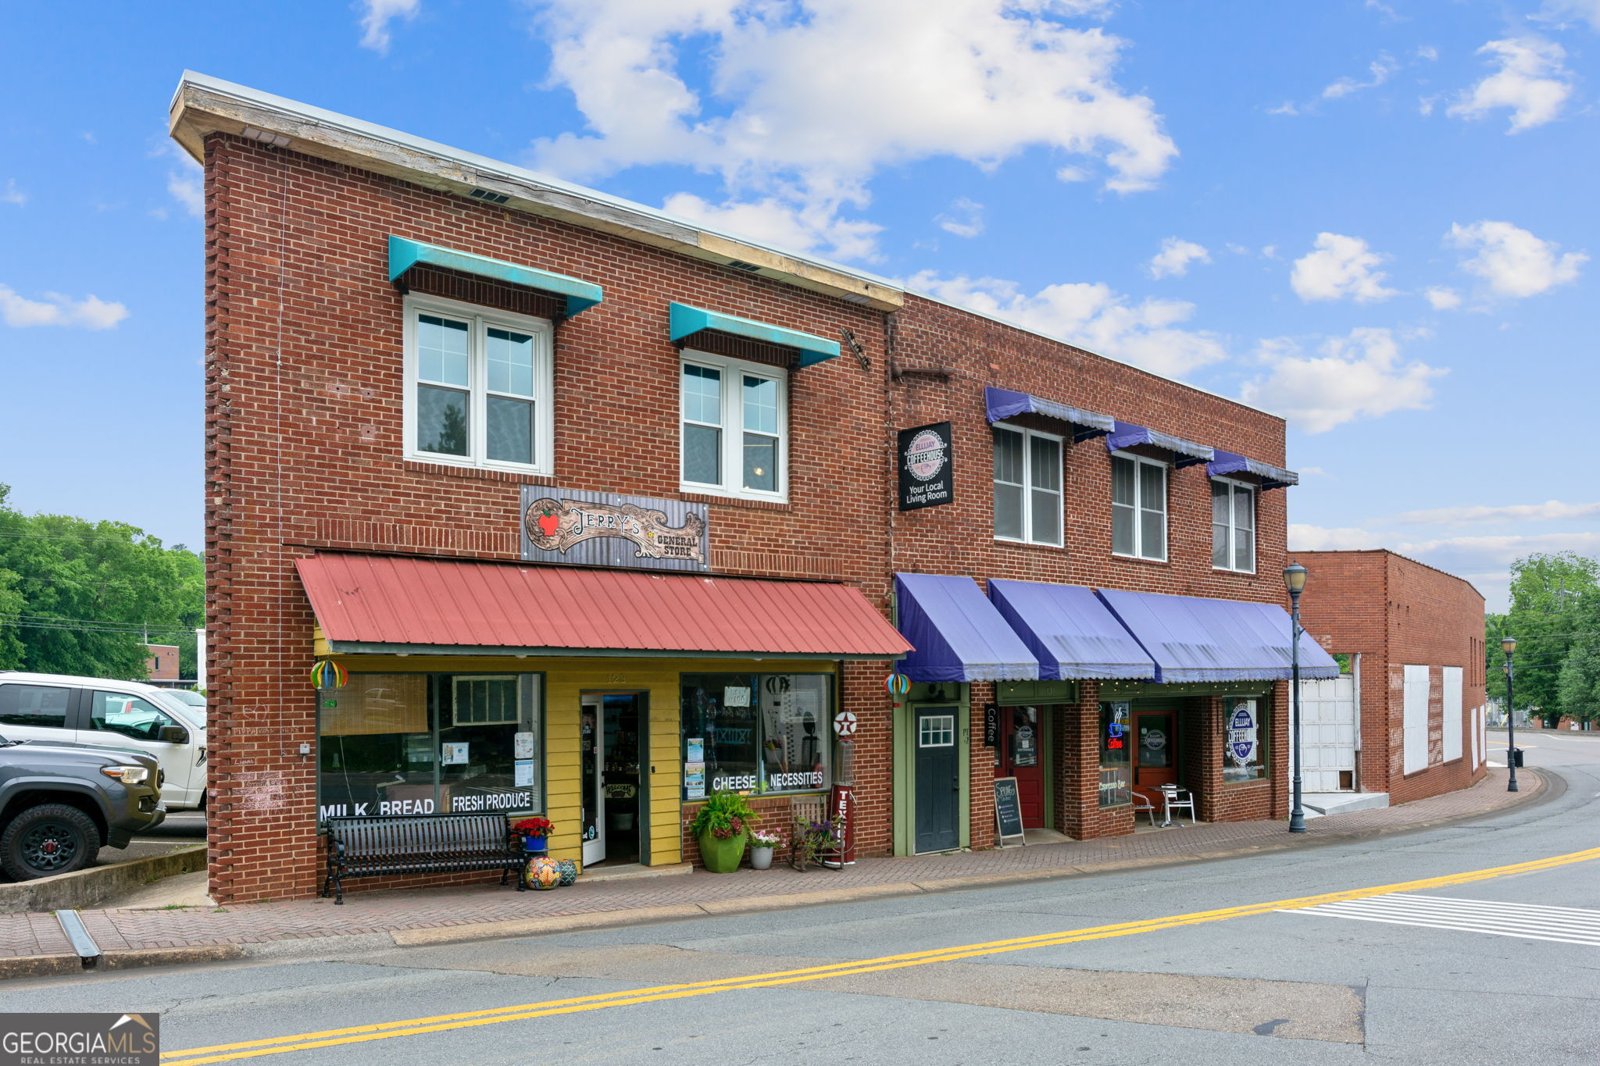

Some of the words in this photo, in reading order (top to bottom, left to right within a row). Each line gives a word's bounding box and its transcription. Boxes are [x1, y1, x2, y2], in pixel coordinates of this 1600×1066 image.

[916, 441, 935, 451] ELLIJAY
[907, 449, 943, 464] COFFEEHOUSE
[909, 485, 924, 493] Your
[925, 481, 943, 491] Local
[907, 494, 926, 503] Living
[927, 491, 947, 500] Room
[657, 534, 698, 547] GENERAL
[664, 545, 692, 557] STORE
[987, 708, 996, 742] Coffee
[713, 775, 756, 791] CHEESE
[770, 771, 823, 787] NECESSITIES
[452, 795, 484, 812] FRESH
[486, 792, 531, 810] PRODUCE
[320, 802, 368, 822] MILK
[380, 799, 434, 816] BREAD
